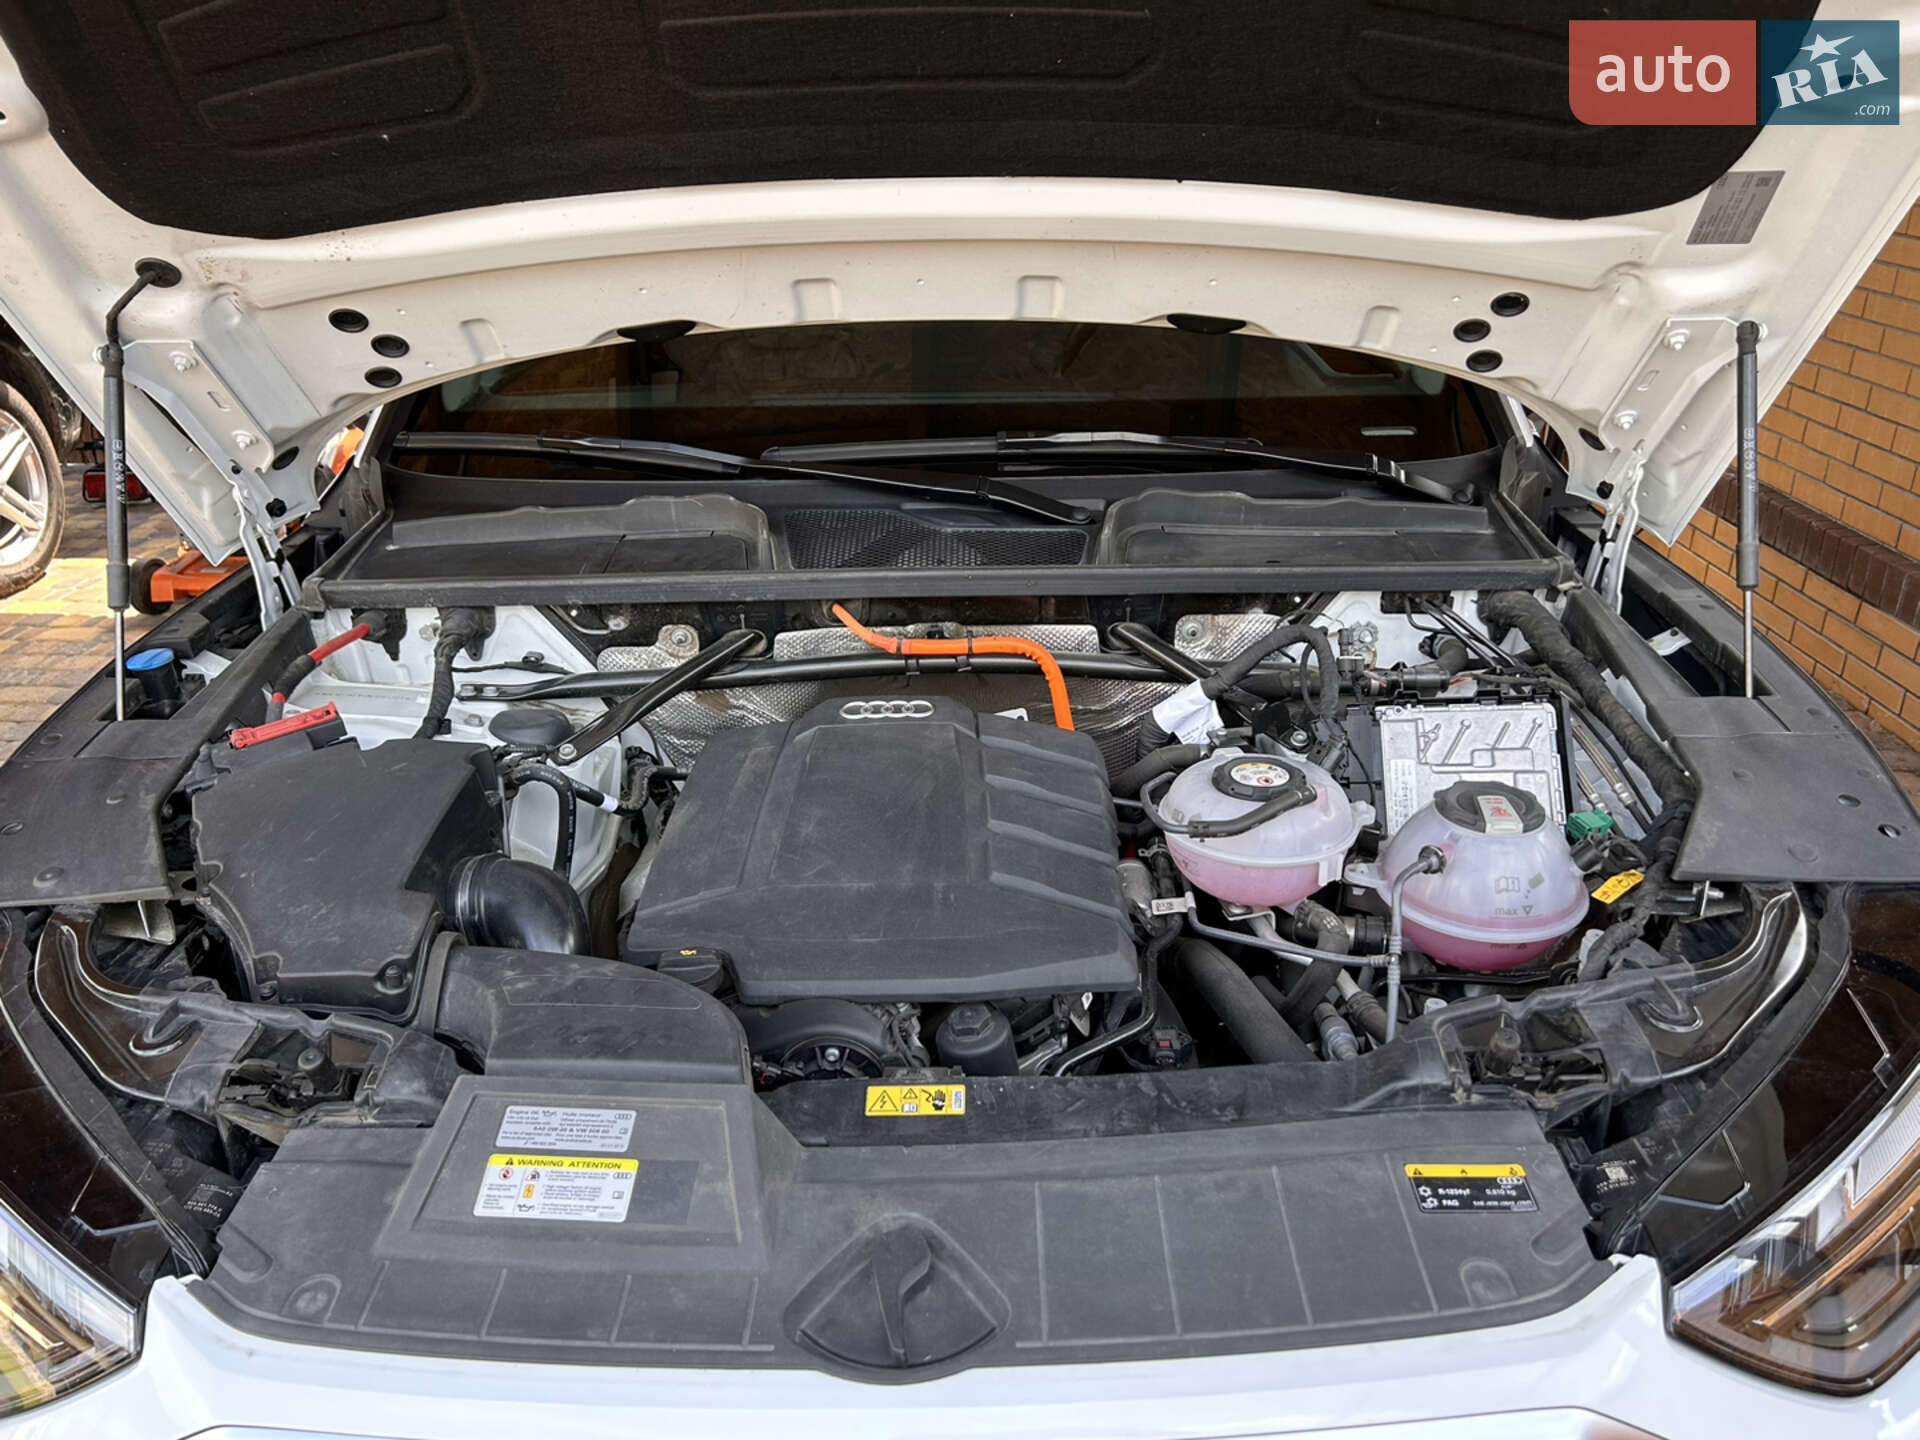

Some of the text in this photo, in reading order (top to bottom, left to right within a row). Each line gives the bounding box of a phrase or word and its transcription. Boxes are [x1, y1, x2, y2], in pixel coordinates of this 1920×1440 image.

[1496, 907, 1518, 915] max
[518, 1159, 622, 1170] WARNING ATTENTION
